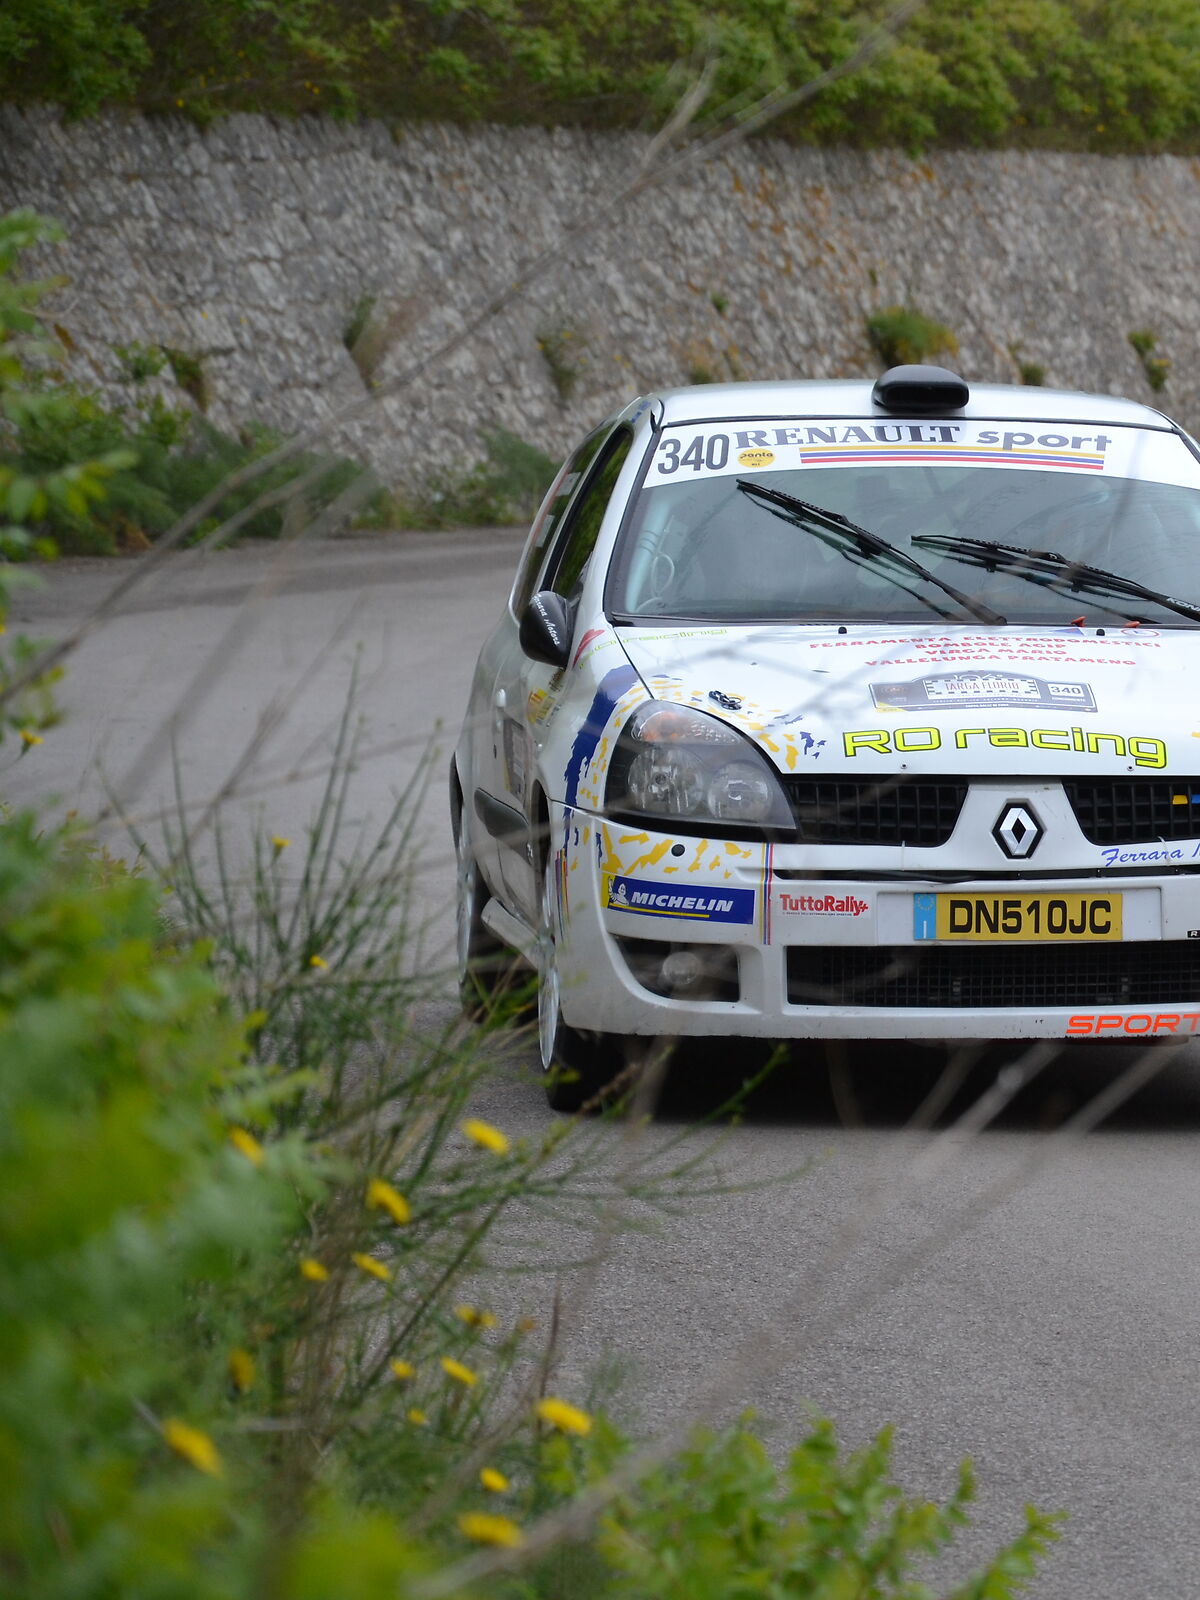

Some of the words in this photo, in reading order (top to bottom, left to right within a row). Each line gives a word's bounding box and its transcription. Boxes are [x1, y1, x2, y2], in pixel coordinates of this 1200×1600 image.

[733, 425, 960, 449] RENAULT
[976, 431, 1112, 451] sport
[657, 433, 730, 475] 340
[809, 636, 951, 648] FERRAMENTA
[963, 636, 1161, 648] ELETTRODOMESTICI
[864, 655, 1001, 666] VALLELUNGA
[1007, 655, 1136, 665] PRATAMENO
[944, 682, 980, 691] TARGA
[981, 681, 1020, 691] FLORIO
[1050, 686, 1082, 694] 340
[842, 726, 942, 758] RO
[955, 726, 1168, 770] racing
[1101, 848, 1184, 867] Ferrara
[631, 891, 734, 912] MICHELIN
[949, 900, 1111, 935] DN510JC
